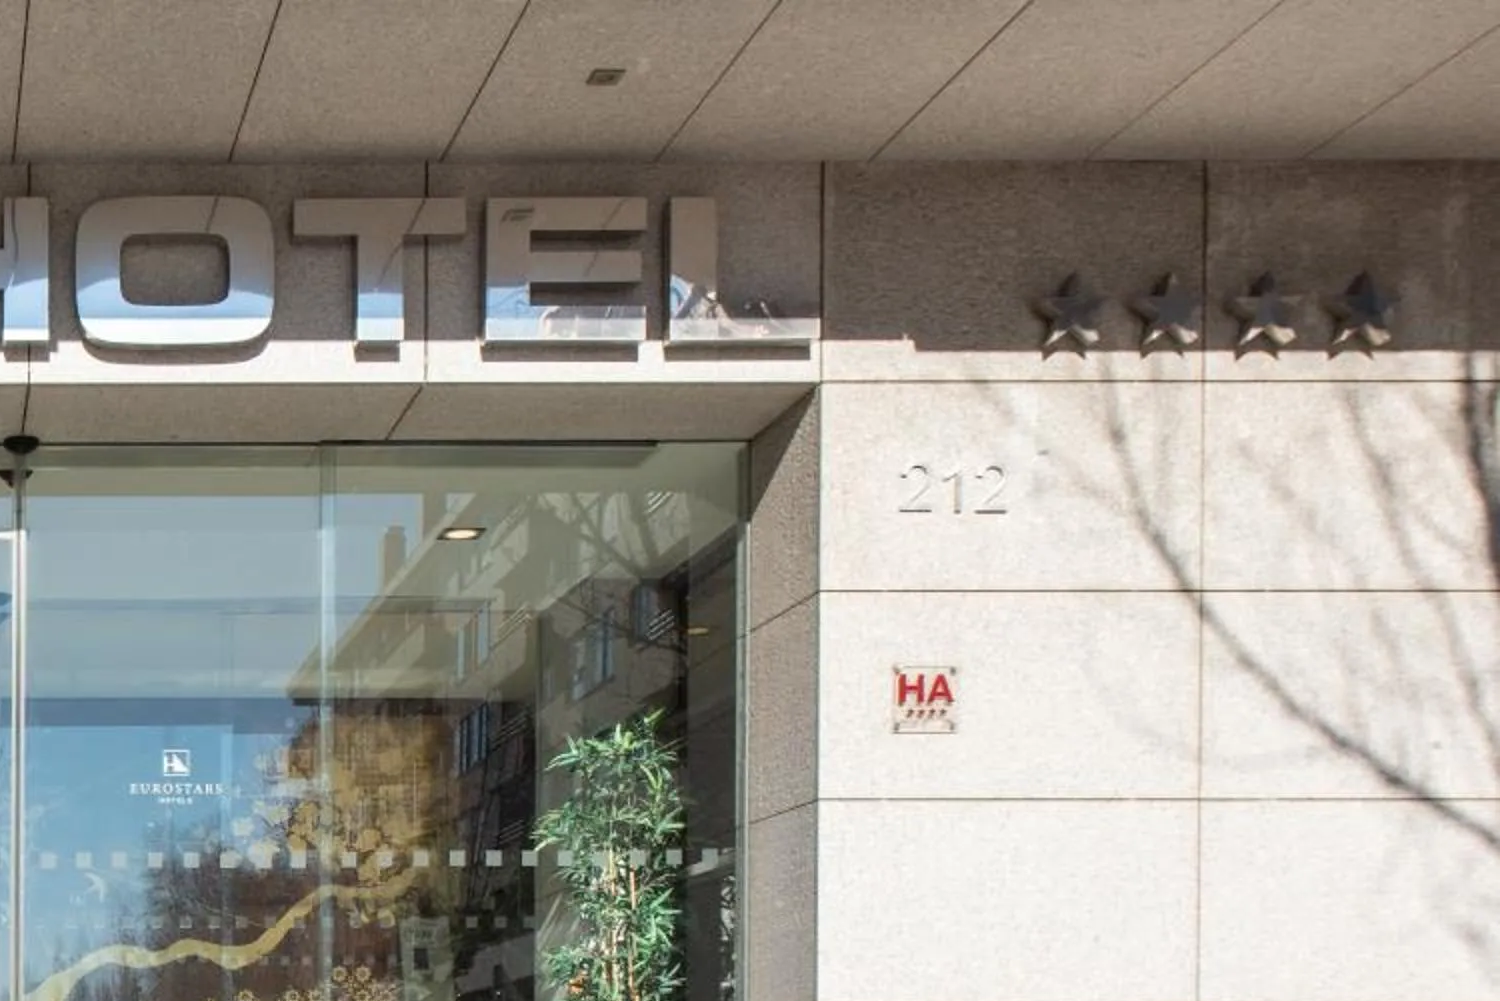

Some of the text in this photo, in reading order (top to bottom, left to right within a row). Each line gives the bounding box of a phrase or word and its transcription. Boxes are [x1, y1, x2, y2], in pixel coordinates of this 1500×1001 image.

[899, 464, 1008, 515] 212
[898, 673, 954, 705] HA
[129, 783, 223, 795] EUROSTARS
